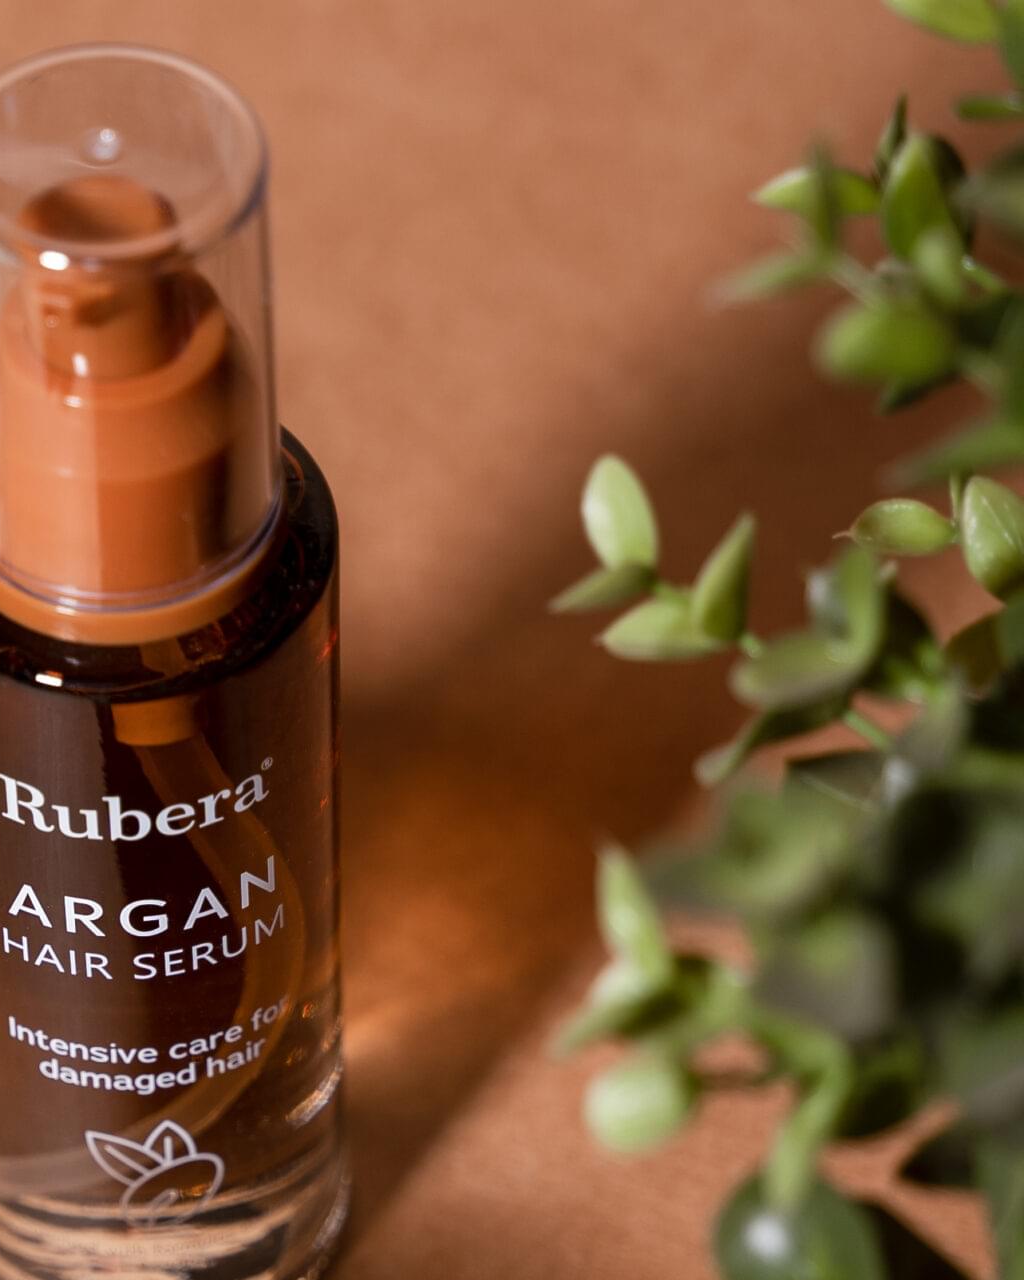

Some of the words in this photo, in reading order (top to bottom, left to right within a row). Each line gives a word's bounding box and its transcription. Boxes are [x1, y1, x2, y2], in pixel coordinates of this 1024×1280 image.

[9, 855, 277, 937] ARGAN
[3, 927, 112, 980] HAIR
[133, 903, 284, 981] SERUM
[9, 1017, 158, 1065] Intensive
[169, 1026, 242, 1061] care
[251, 995, 290, 1033] for
[39, 1059, 196, 1096] damaged
[207, 1039, 267, 1078] hair
